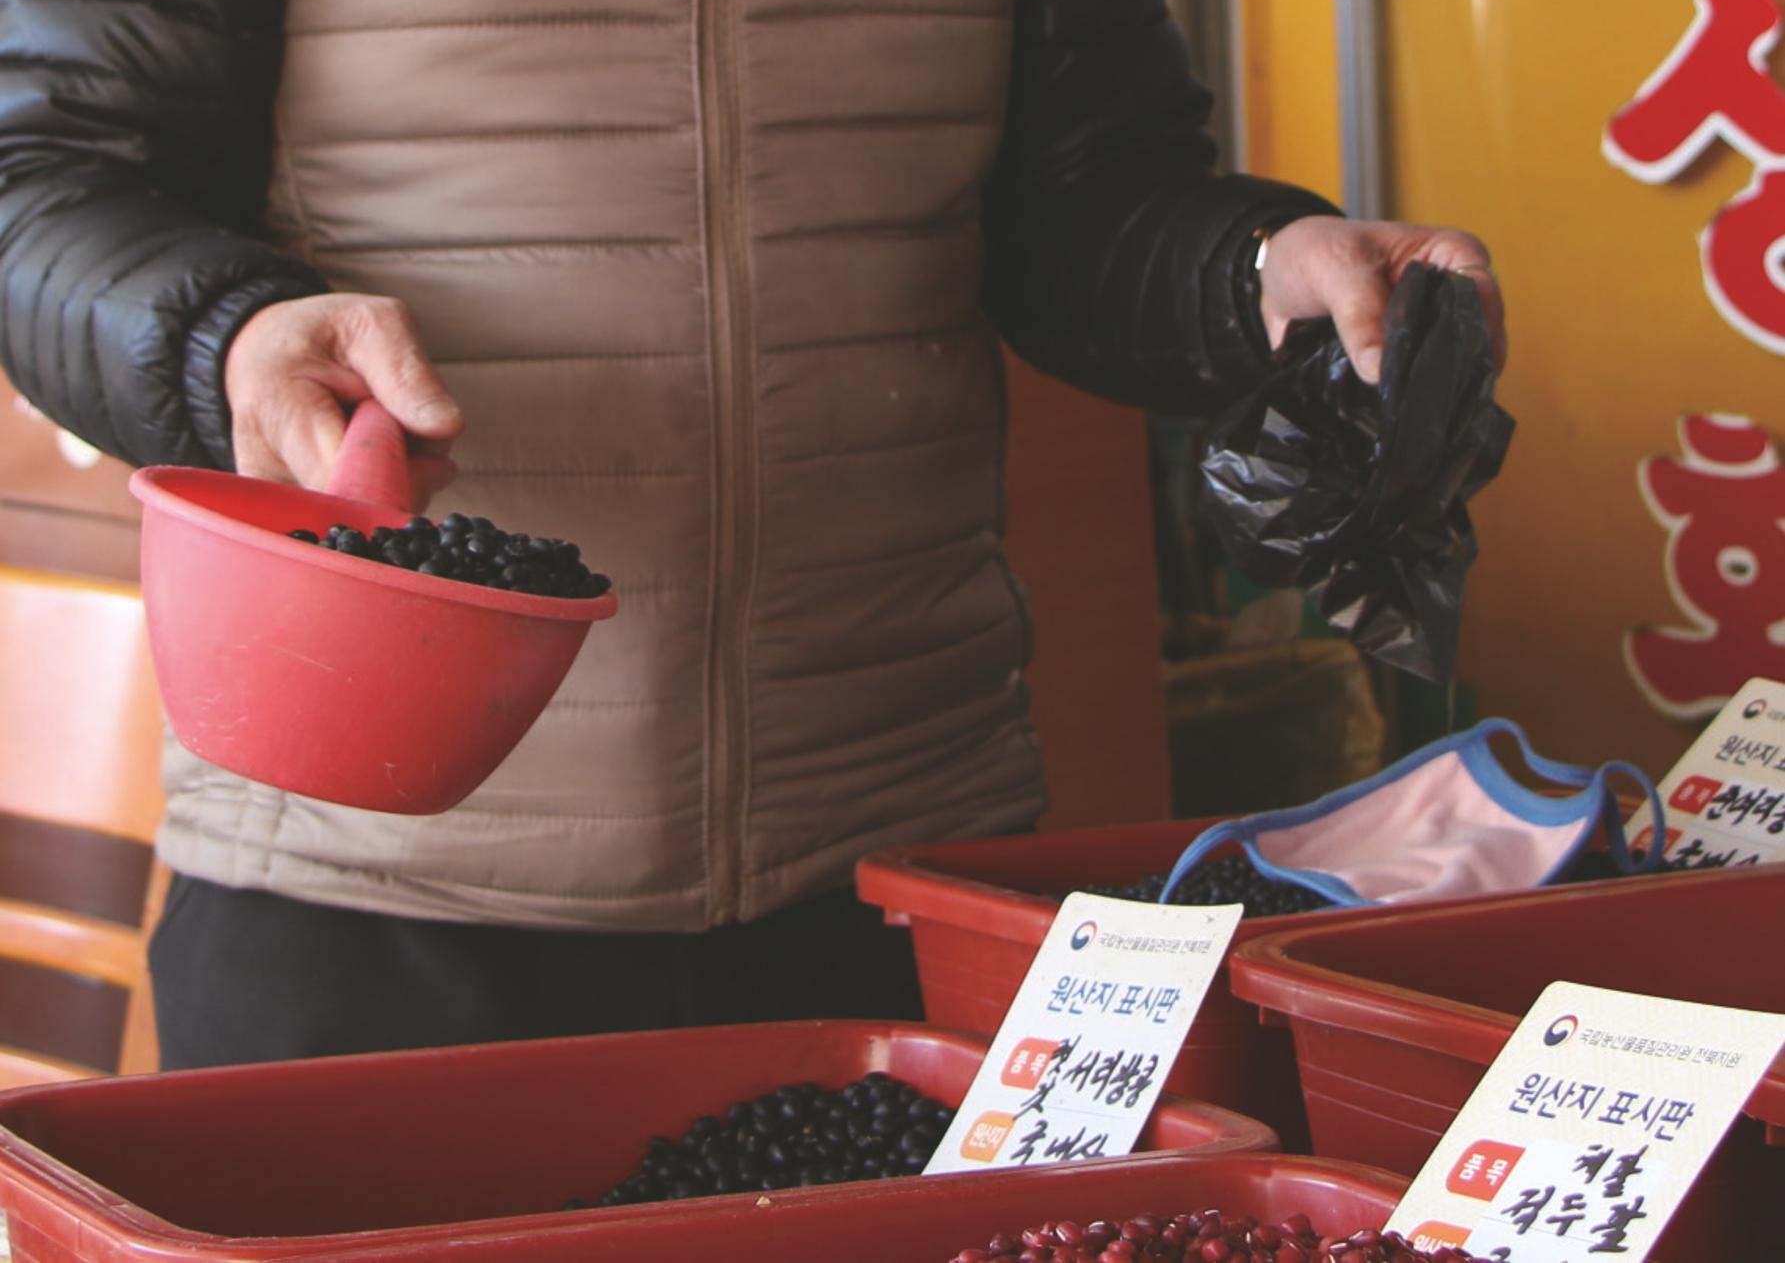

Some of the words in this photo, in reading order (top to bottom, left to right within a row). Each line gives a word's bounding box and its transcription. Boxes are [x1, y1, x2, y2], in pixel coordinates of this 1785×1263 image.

[1714, 734, 1780, 768] 원산지
[1047, 975, 1114, 1017] 원산지
[1112, 985, 1182, 1025] 표시판
[1508, 1072, 1605, 1120] 원산지
[1597, 1090, 1696, 1143] 표시판
